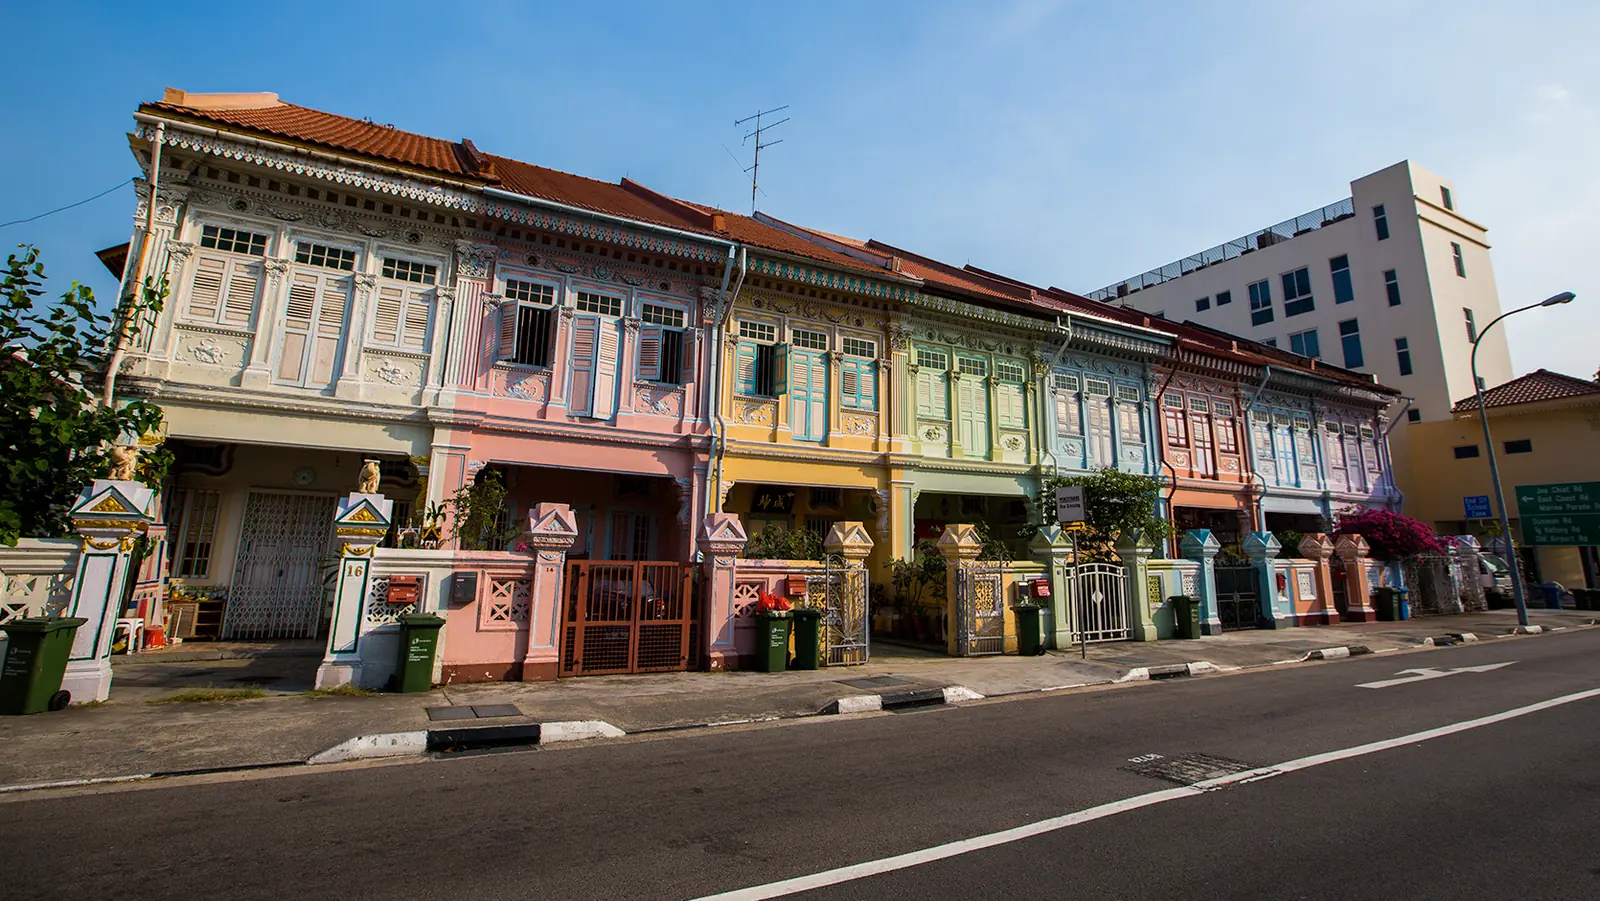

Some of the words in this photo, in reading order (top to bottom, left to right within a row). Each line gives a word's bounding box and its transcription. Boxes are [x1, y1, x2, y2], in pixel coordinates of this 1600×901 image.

[1573, 484, 1583, 493] Rd
[1537, 495, 1553, 503] East
[1555, 494, 1577, 502] Coast
[1579, 493, 1589, 501] Rd
[1466, 503, 1488, 511] School
[1565, 503, 1591, 511] Parade
[1562, 516, 1573, 524] Rd
[1571, 525, 1581, 533] Rd
[1550, 535, 1575, 543] Airport
[1578, 534, 1589, 542] Rd
[346, 564, 363, 577] 16
